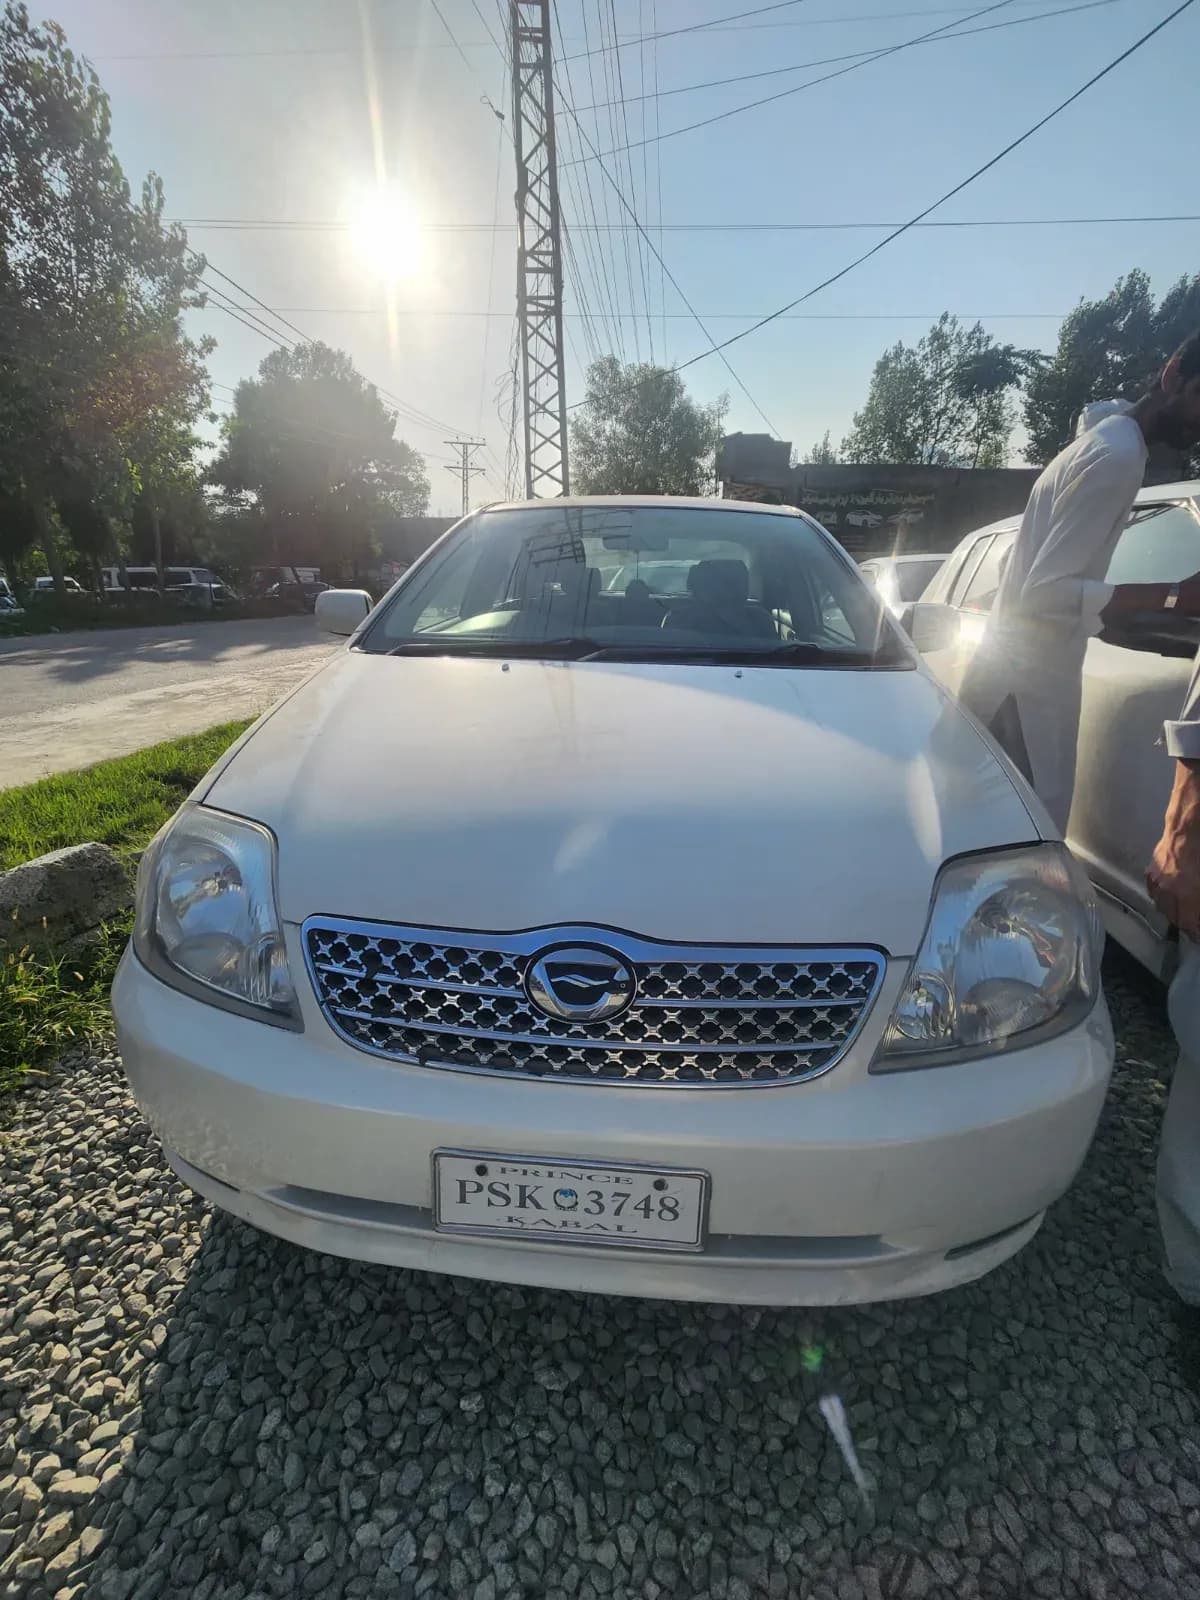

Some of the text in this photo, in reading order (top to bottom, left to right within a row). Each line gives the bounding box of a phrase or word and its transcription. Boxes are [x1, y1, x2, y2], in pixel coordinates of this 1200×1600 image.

[500, 1167, 634, 1185] PRINCE
[455, 1179, 680, 1222] PSK 3748
